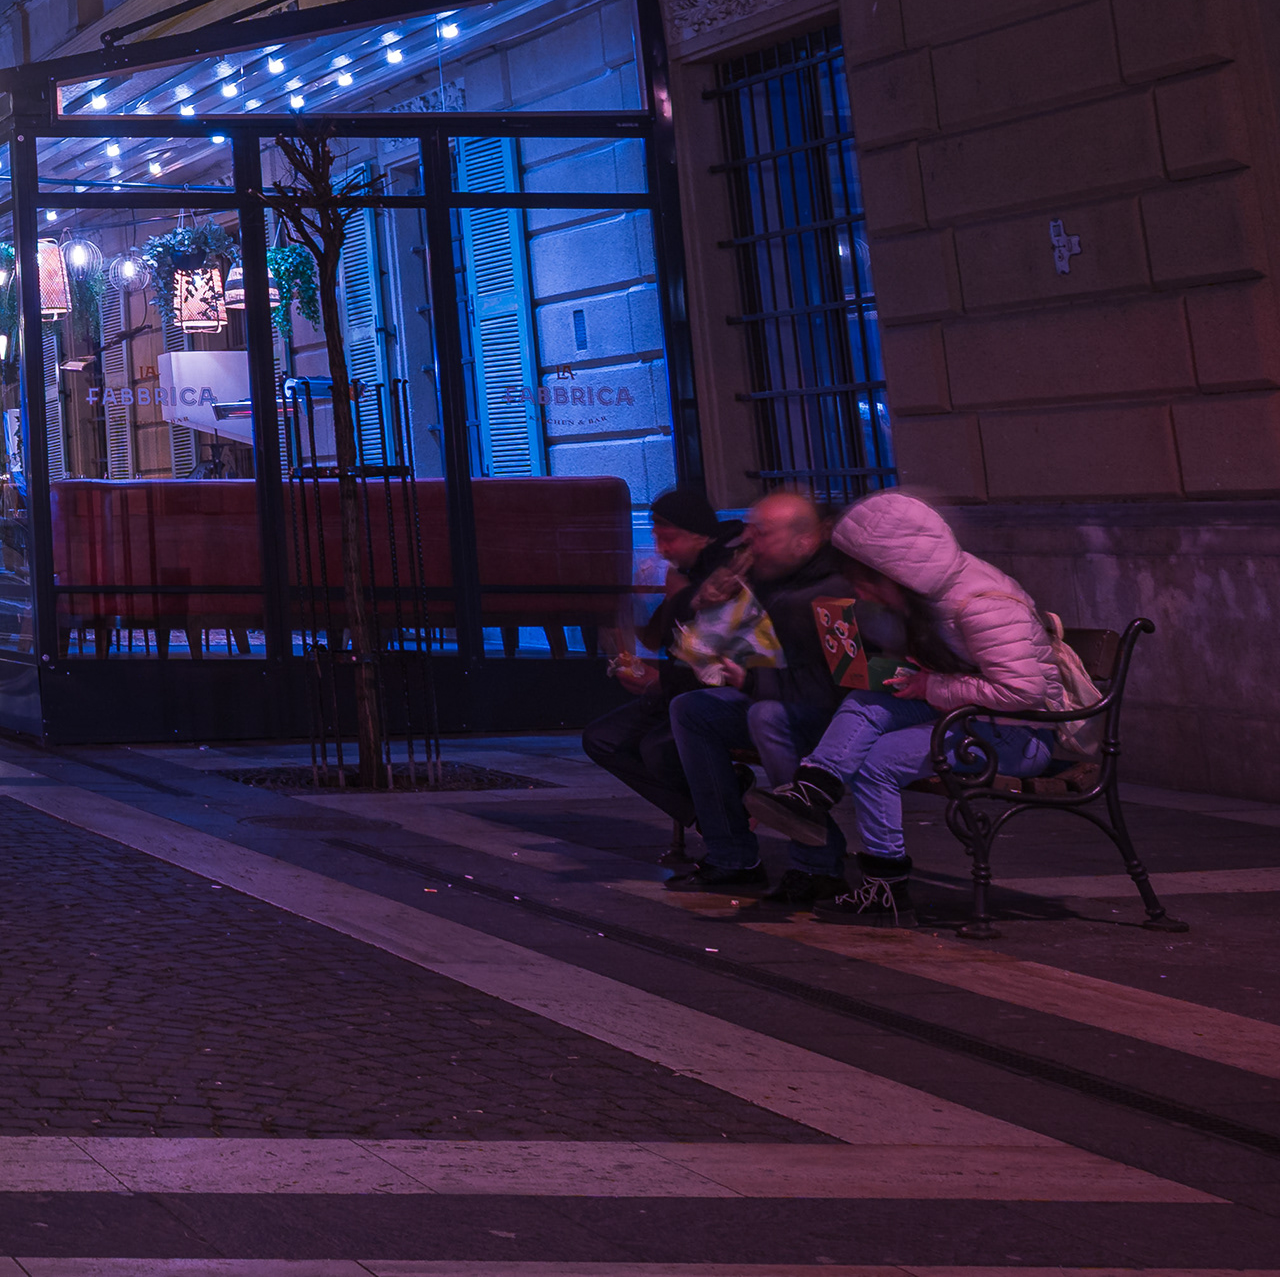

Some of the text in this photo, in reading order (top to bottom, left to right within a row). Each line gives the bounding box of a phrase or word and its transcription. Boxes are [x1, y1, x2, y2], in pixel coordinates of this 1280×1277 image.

[556, 365, 577, 380] LA
[86, 386, 218, 407] FABBRICA
[502, 385, 634, 407] FABBRICA
[588, 416, 608, 425] BAR
